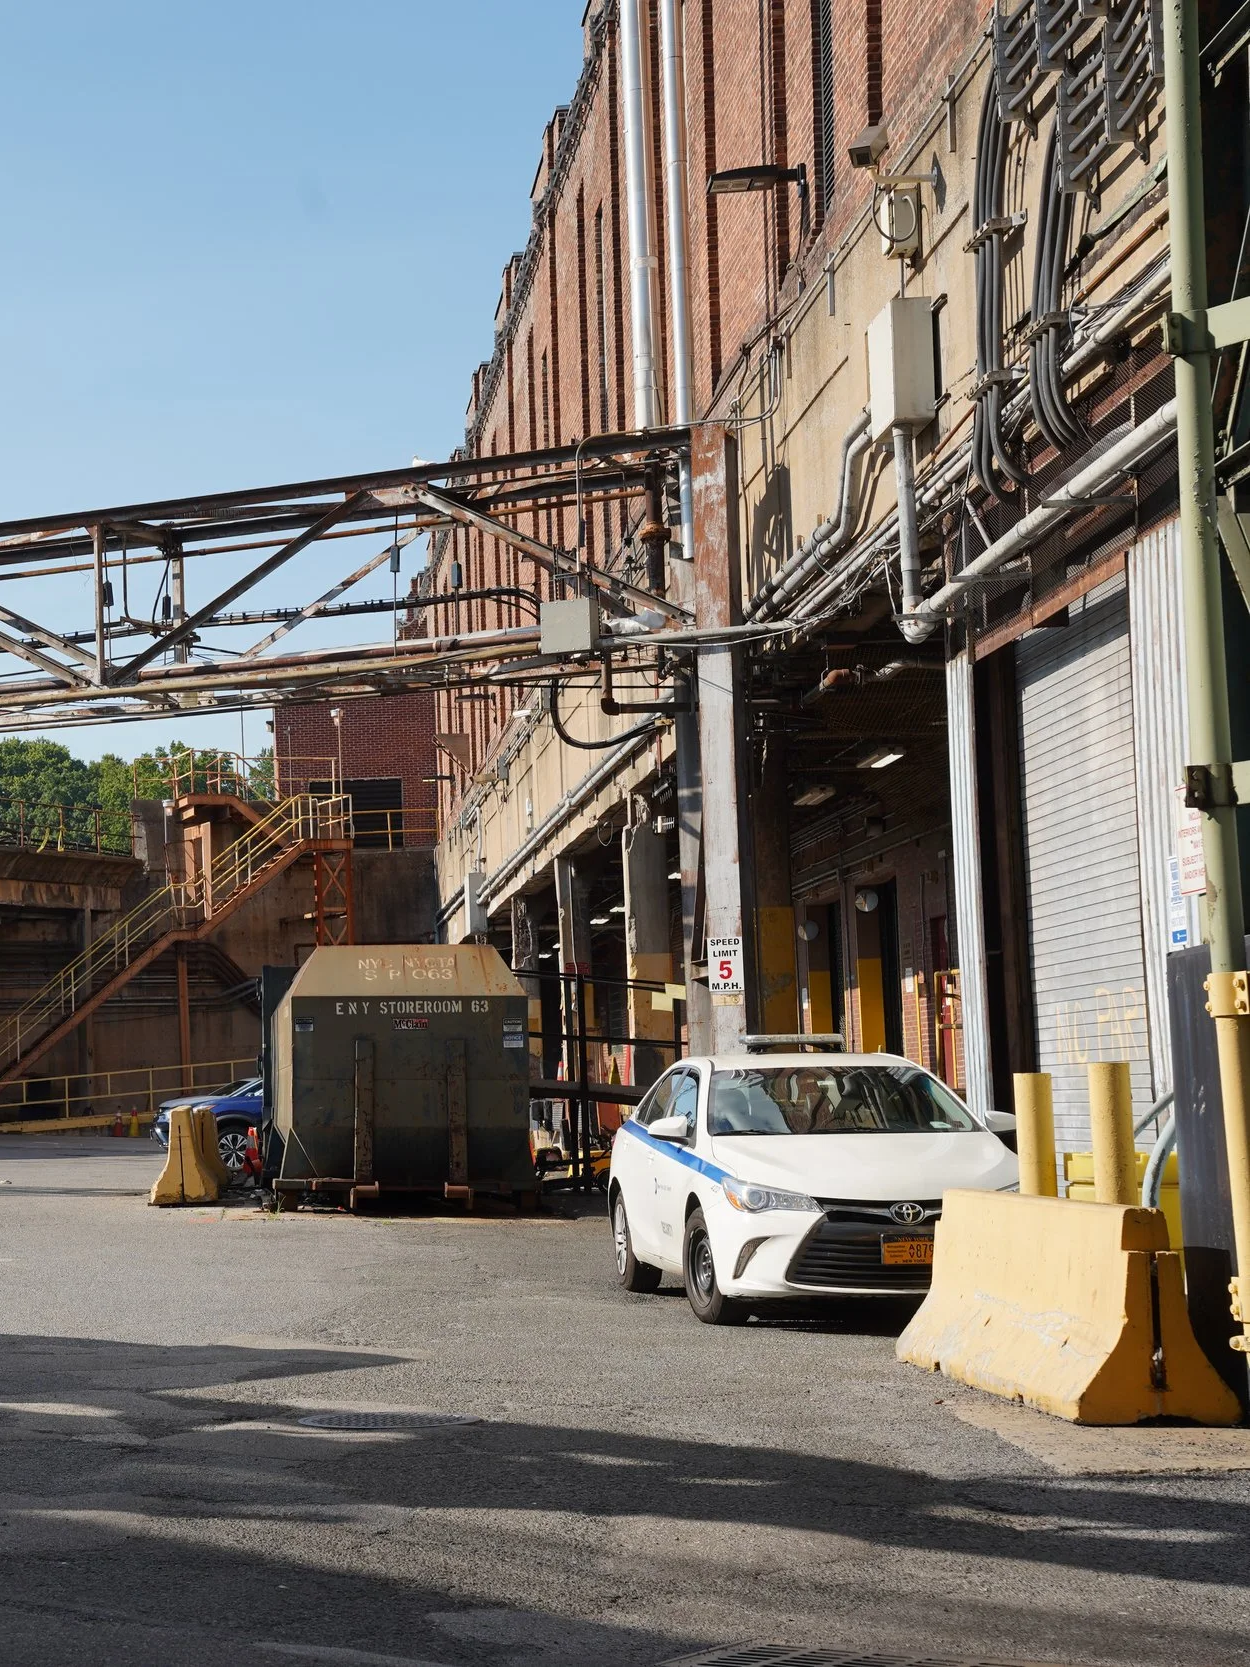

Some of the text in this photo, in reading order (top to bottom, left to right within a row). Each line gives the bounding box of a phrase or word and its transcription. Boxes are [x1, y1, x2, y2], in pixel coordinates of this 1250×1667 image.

[710, 938, 740, 946] SPEED
[713, 950, 738, 958] LIMIT
[719, 960, 732, 980] 5
[712, 982, 742, 990] M.P.H.
[379, 1000, 462, 1014] STOREROOM
[471, 1000, 489, 1013] 63
[1056, 1001, 1088, 1063] NO
